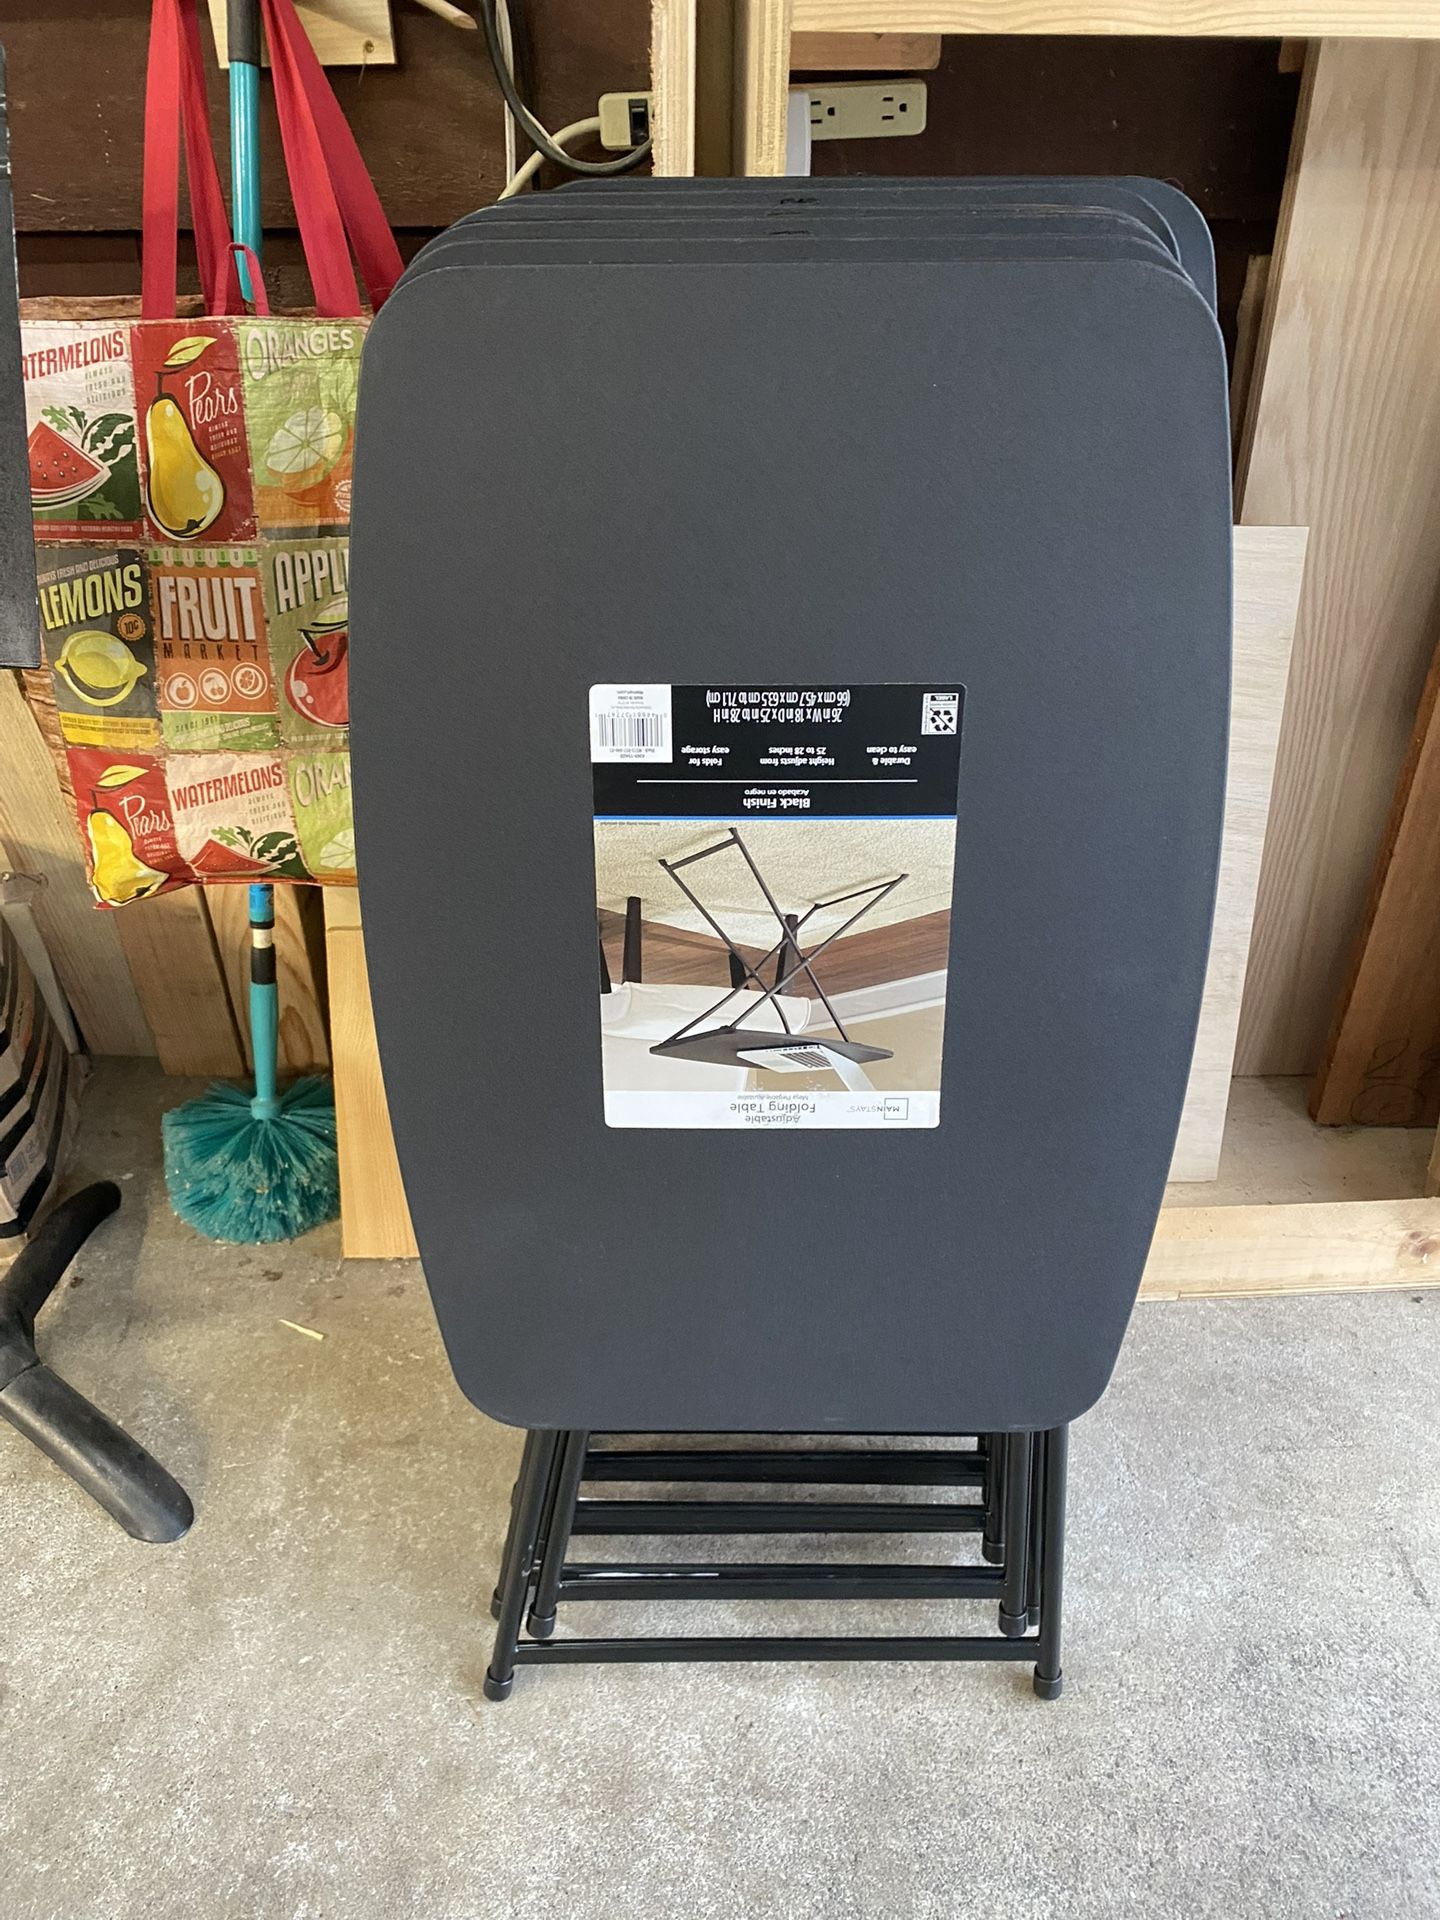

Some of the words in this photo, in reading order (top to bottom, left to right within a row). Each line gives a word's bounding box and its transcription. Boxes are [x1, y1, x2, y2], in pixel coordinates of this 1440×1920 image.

[246, 327, 354, 381] ORANGES
[184, 370, 238, 430] Pears
[40, 563, 143, 630] LEMONS
[157, 576, 257, 641] FRUIT
[162, 642, 258, 661] MARKET
[706, 689, 721, 708] cm)
[722, 691, 738, 707] 71.1
[738, 691, 748, 705] to
[748, 691, 760, 703] cm
[761, 691, 779, 707] 63.5
[779, 691, 786, 703] x
[786, 691, 799, 703] cm
[798, 691, 817, 707] 45.7
[817, 691, 824, 703] x
[823, 691, 836, 703] cm
[836, 689, 851, 708] (66
[713, 708, 721, 723] H
[721, 708, 729, 723] in
[730, 708, 741, 723] 28
[742, 708, 751, 721] to
[751, 708, 760, 723] in
[760, 708, 771, 723] 25
[772, 708, 778, 720] x
[778, 708, 785, 723] D
[786, 708, 794, 723] in
[794, 708, 805, 723] 18
[806, 708, 812, 719] x
[812, 708, 822, 723] W
[823, 708, 831, 723] in
[831, 708, 843, 723] 26
[681, 745, 711, 754] storage
[711, 745, 730, 753] easy
[768, 747, 794, 755] inches
[866, 747, 888, 755] clean
[898, 745, 917, 753] easy
[689, 757, 700, 766] for
[701, 757, 723, 766] Folds
[760, 757, 780, 766] from
[780, 756, 808, 766] adjusts
[808, 756, 835, 766] Height
[871, 757, 879, 765] &
[880, 757, 911, 765] Durable
[171, 763, 283, 811] WATERMELONS
[742, 797, 777, 809] Finish
[779, 797, 811, 809] Black
[119, 795, 171, 840] Pears
[729, 1103, 764, 1114] Table
[769, 1101, 816, 1114] Folding
[744, 1114, 801, 1124] Adjustable
